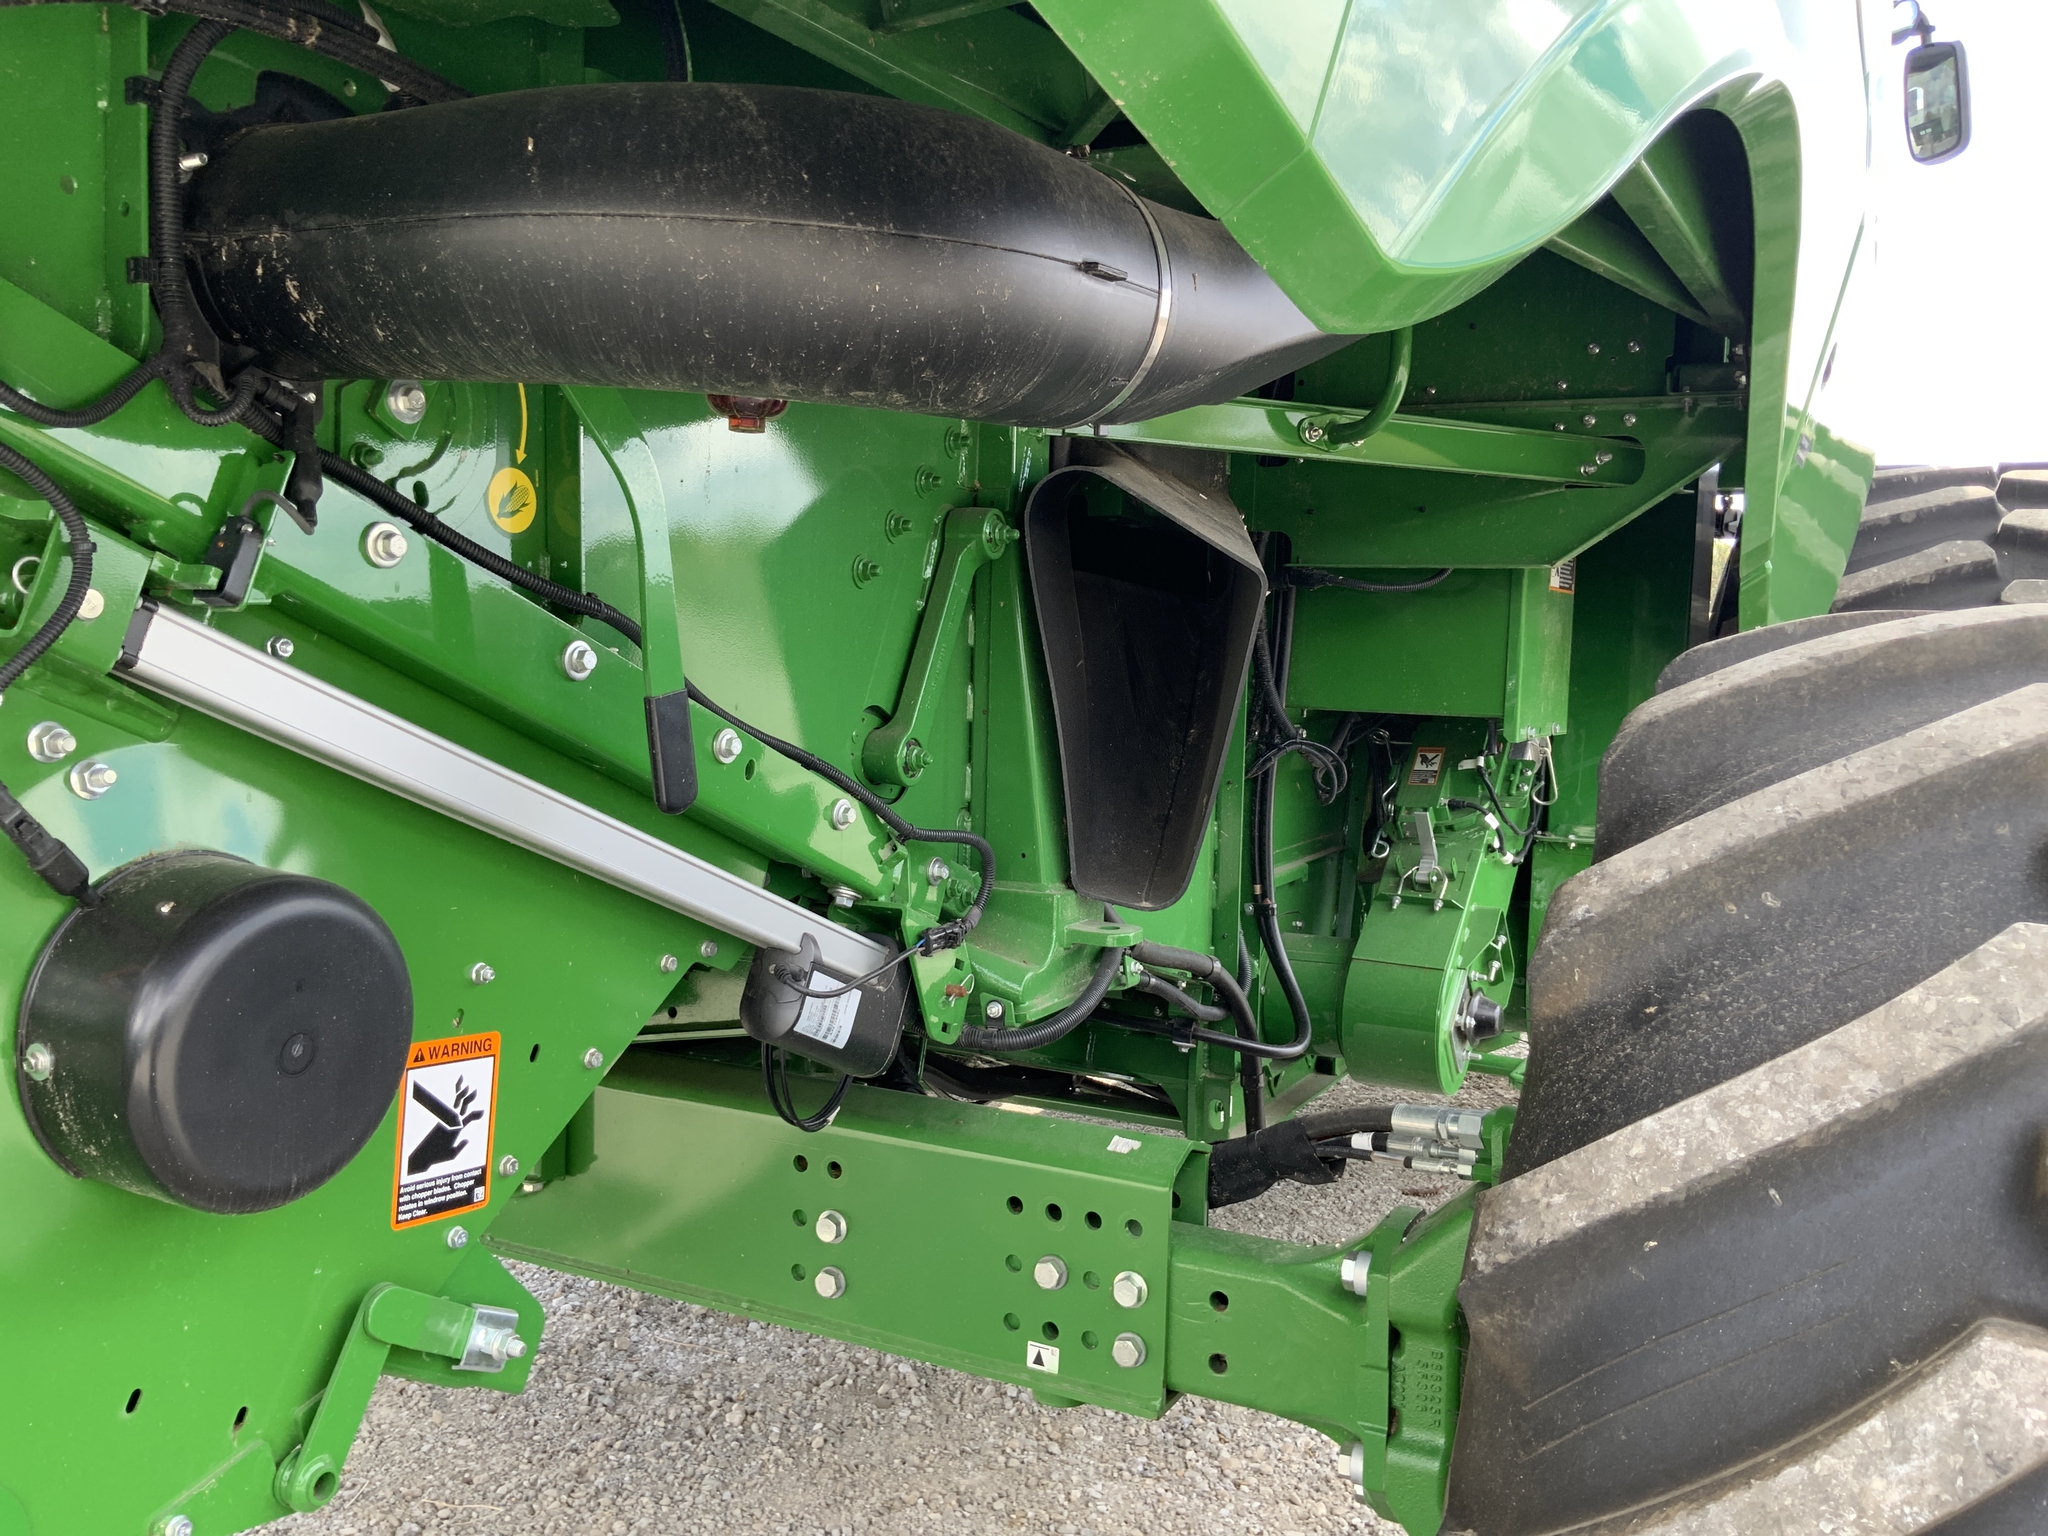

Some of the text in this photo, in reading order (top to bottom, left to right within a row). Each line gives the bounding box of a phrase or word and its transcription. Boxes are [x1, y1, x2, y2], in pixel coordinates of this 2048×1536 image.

[428, 1038, 492, 1060] WARNING
[399, 1168, 482, 1194] Avoid serious injury from contact
[399, 1179, 475, 1203] with chopper blades. Chopper
[398, 1202, 417, 1212] rotates
[424, 1195, 446, 1206] windrow
[446, 1189, 468, 1201] position.
[398, 1208, 428, 1221] Keep Clear.
